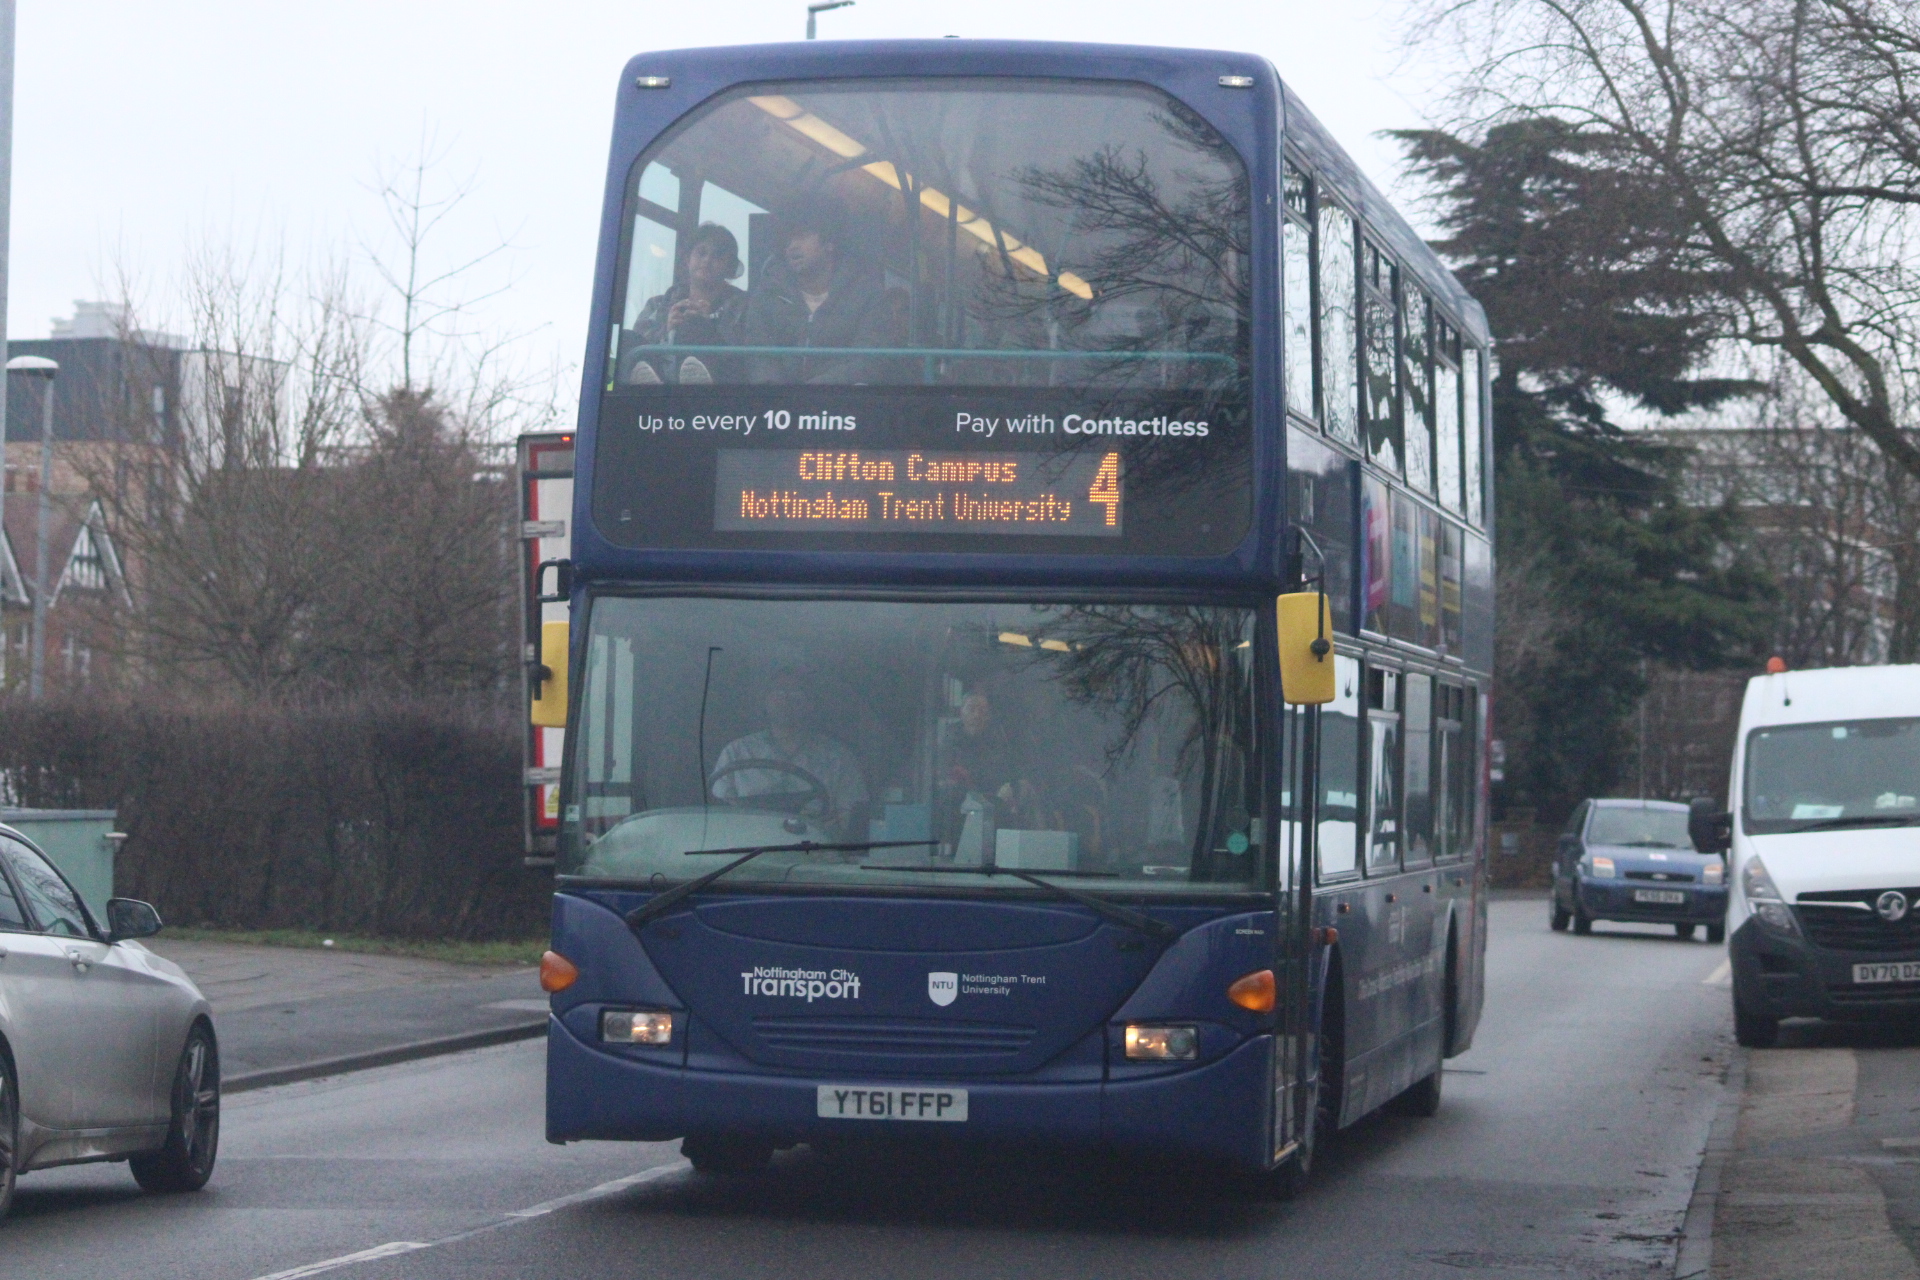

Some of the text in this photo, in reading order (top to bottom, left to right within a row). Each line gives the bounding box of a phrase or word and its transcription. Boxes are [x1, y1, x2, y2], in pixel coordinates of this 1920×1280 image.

[638, 410, 857, 435] Up to every 10 mins
[956, 412, 1209, 437] Pay with Contactless
[799, 453, 1018, 482] Clifton Campus
[1089, 452, 1119, 526] 4
[741, 490, 1072, 521] Nottingham Trent University
[754, 966, 855, 982] Nottingham City
[932, 981, 954, 990] NTU
[962, 974, 1046, 985] Nottingham Trent
[741, 972, 861, 1003] Transport
[962, 985, 1011, 996] University
[834, 1090, 953, 1117] YT61 FFP
